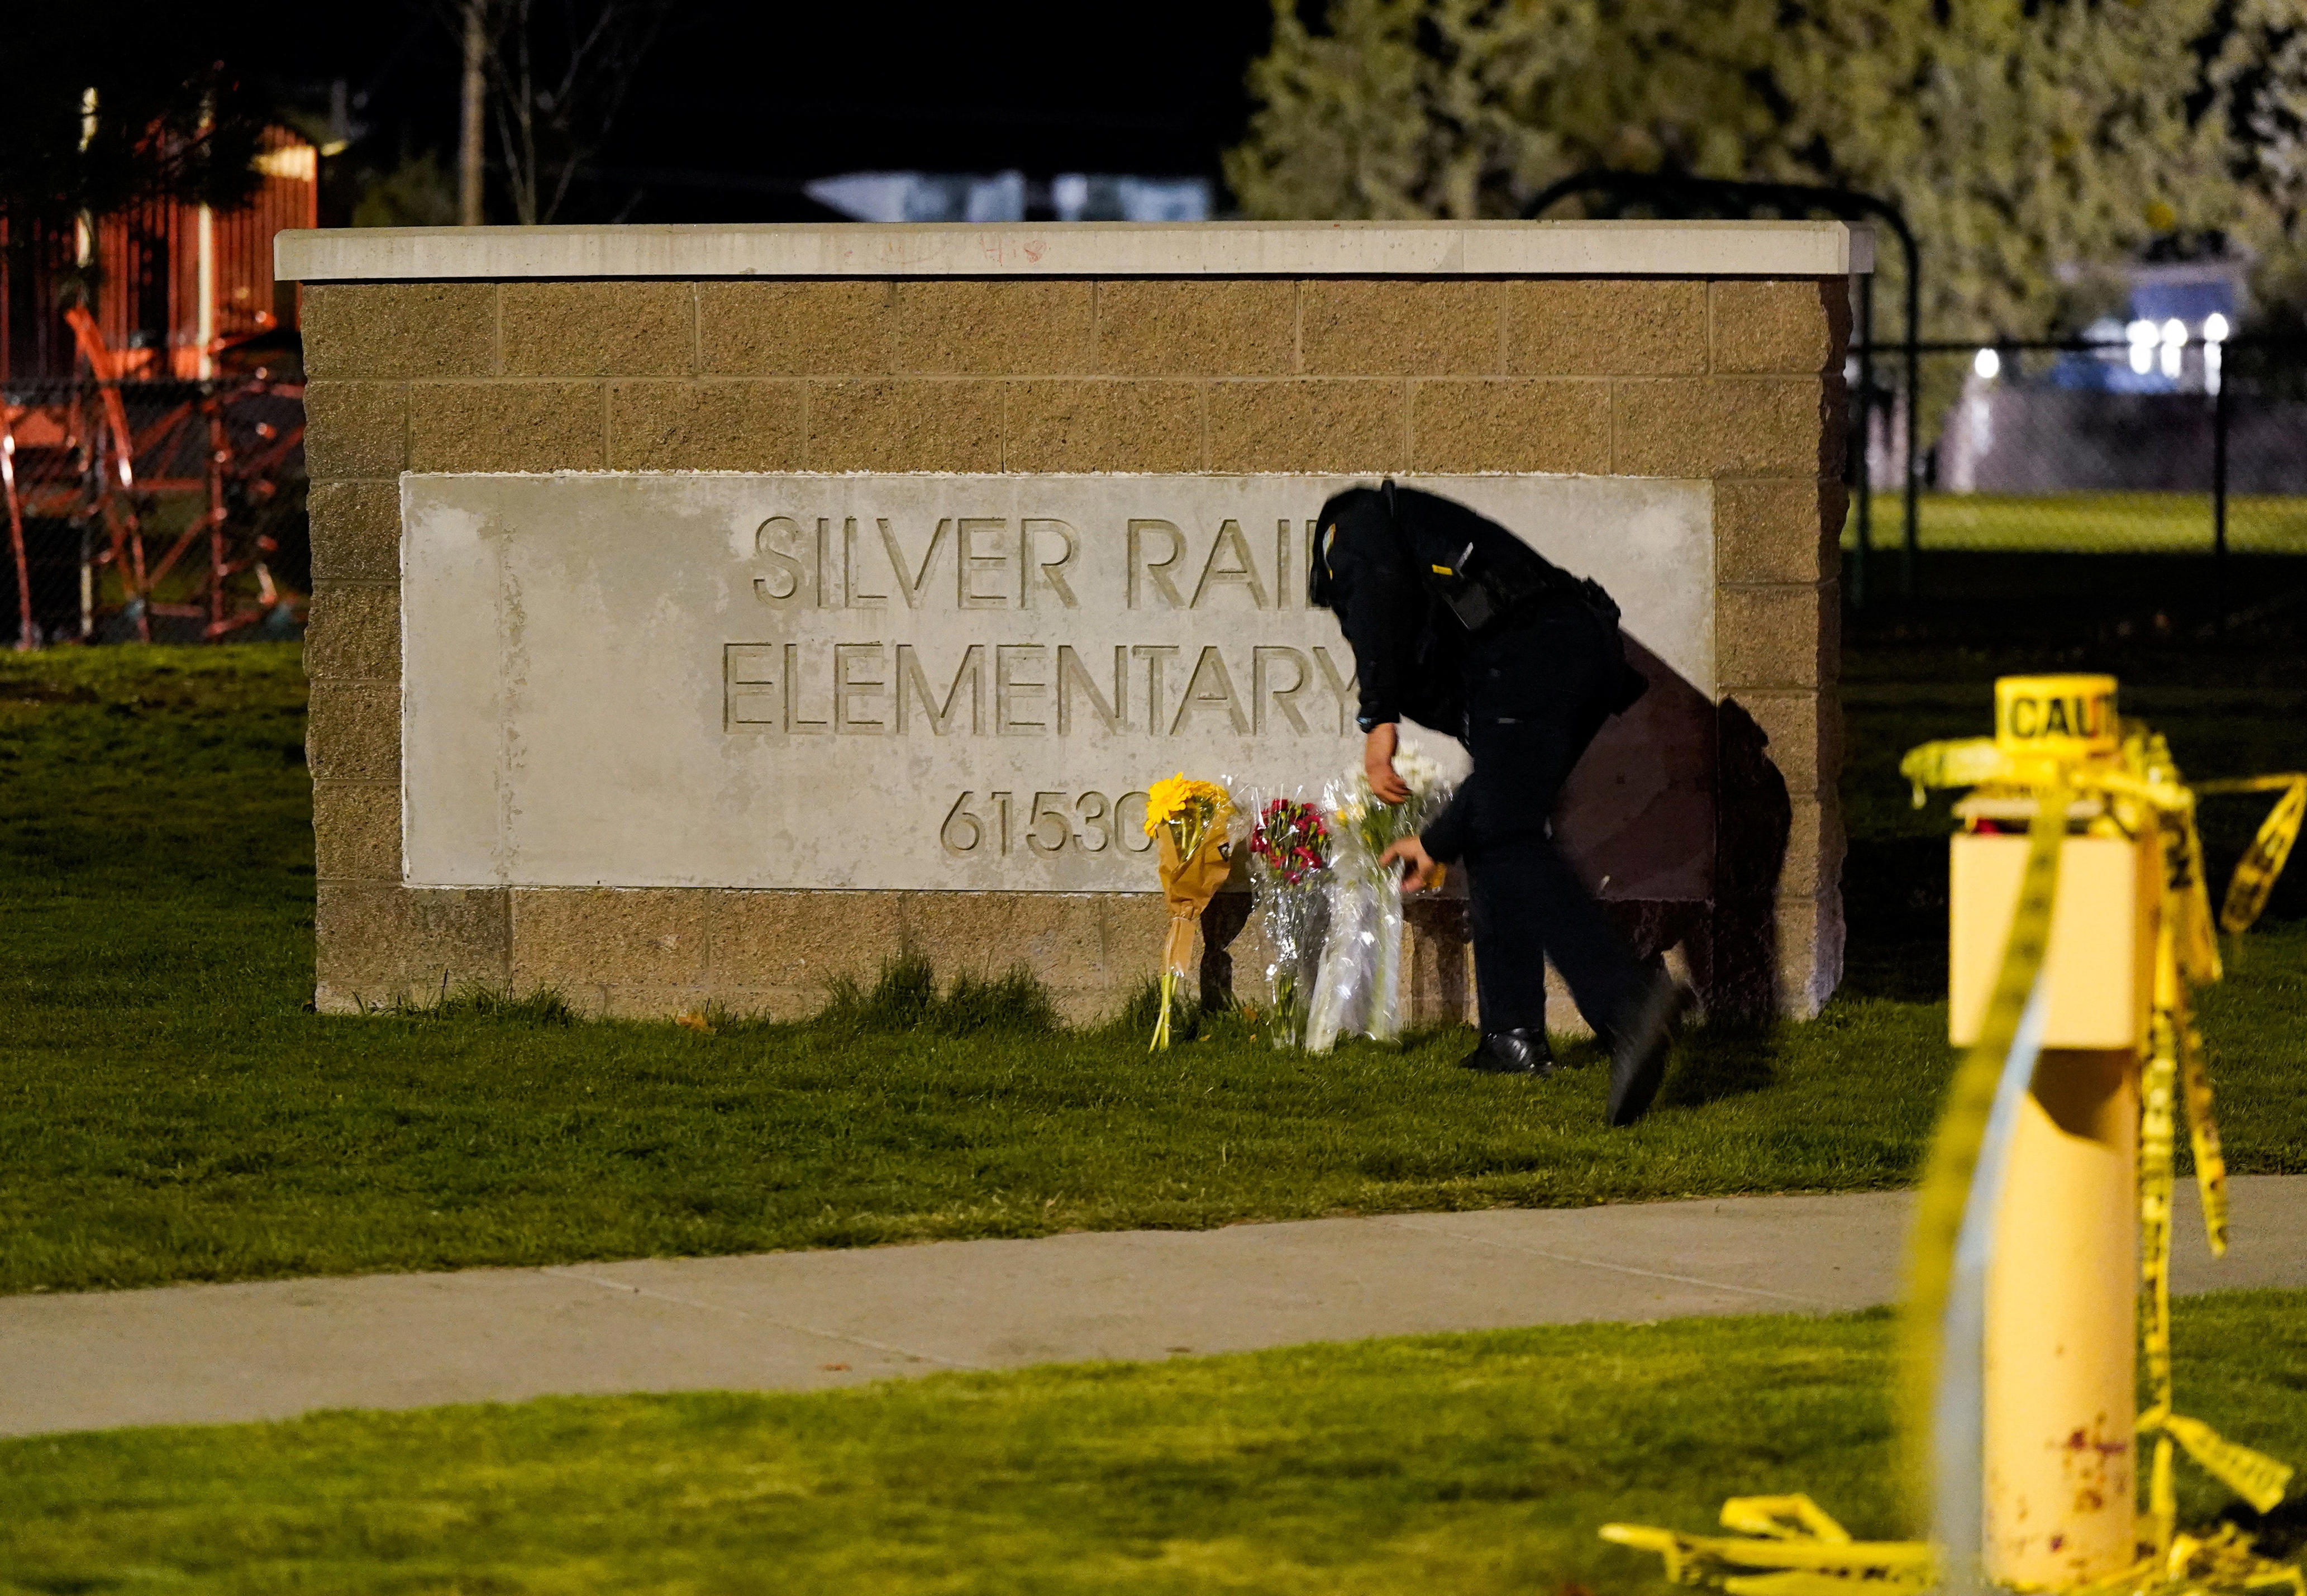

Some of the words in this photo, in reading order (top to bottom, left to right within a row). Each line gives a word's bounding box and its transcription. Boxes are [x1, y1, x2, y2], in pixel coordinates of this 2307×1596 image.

[753, 516, 1081, 609] SILVER
[723, 641, 1360, 737] ELEMENTARY
[940, 791, 1155, 859] 61530
